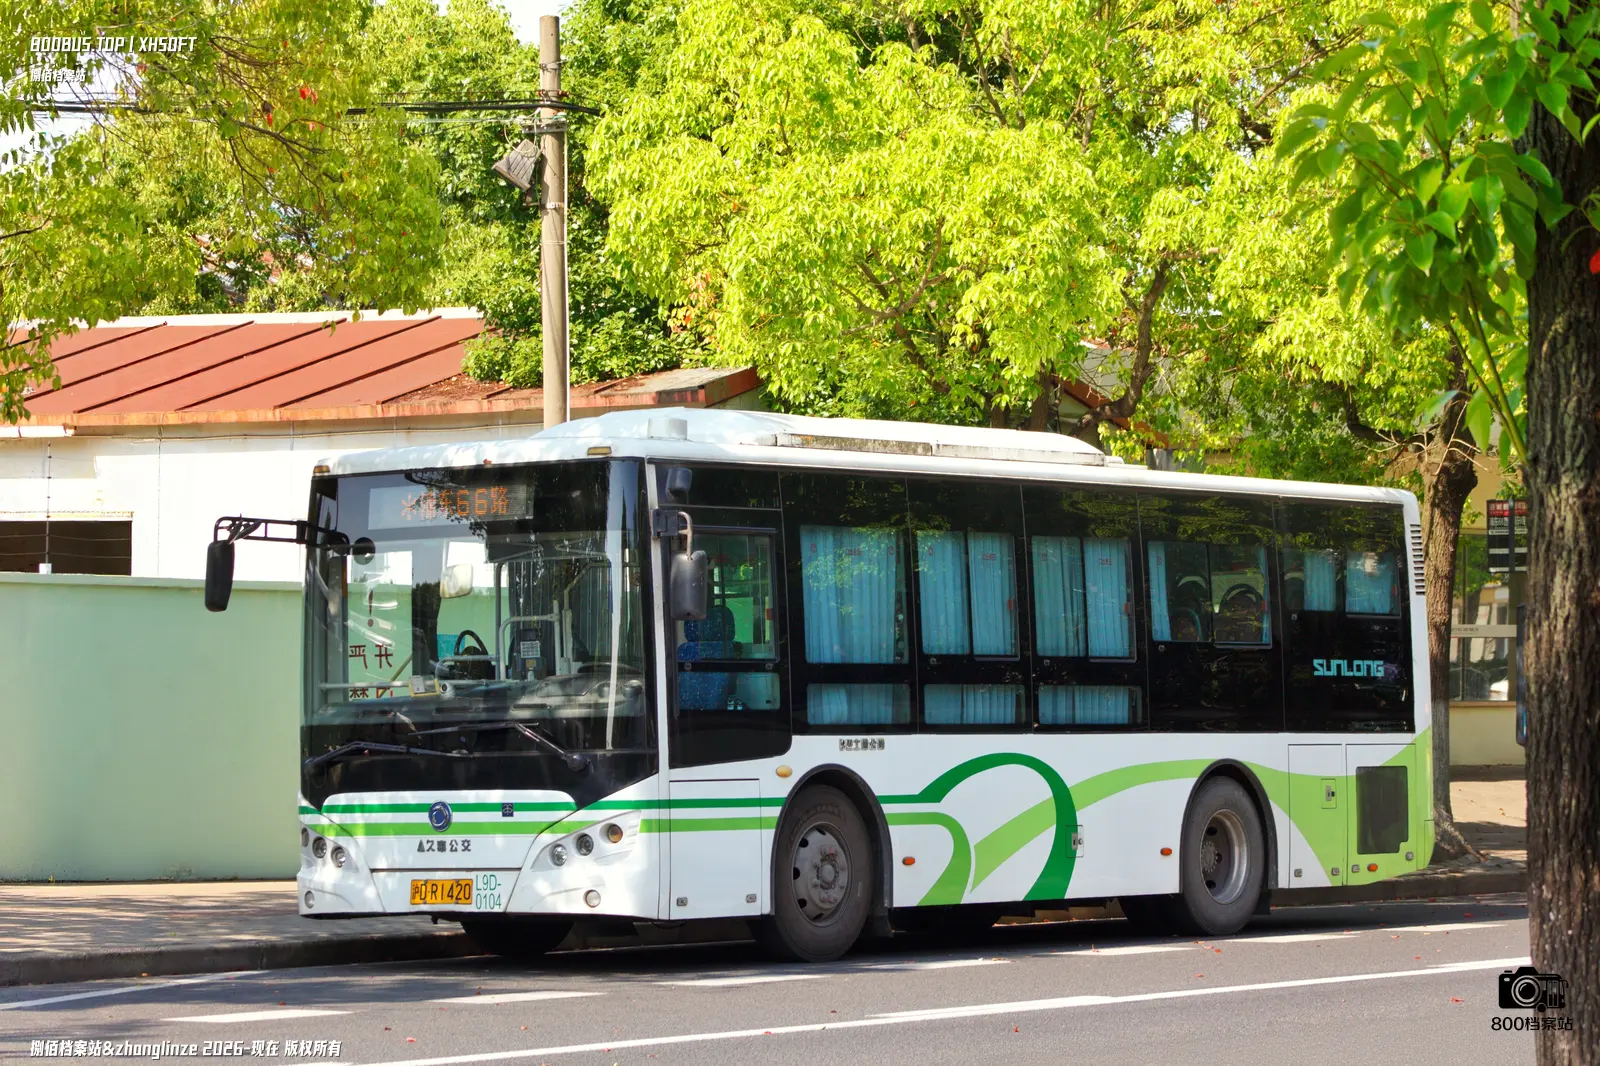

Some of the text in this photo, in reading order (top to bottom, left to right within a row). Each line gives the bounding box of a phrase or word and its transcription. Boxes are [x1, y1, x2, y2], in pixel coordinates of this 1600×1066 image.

[1312, 658, 1385, 677] SUNLONG
[475, 874, 502, 891] L9D-
[475, 893, 502, 910] 0104
